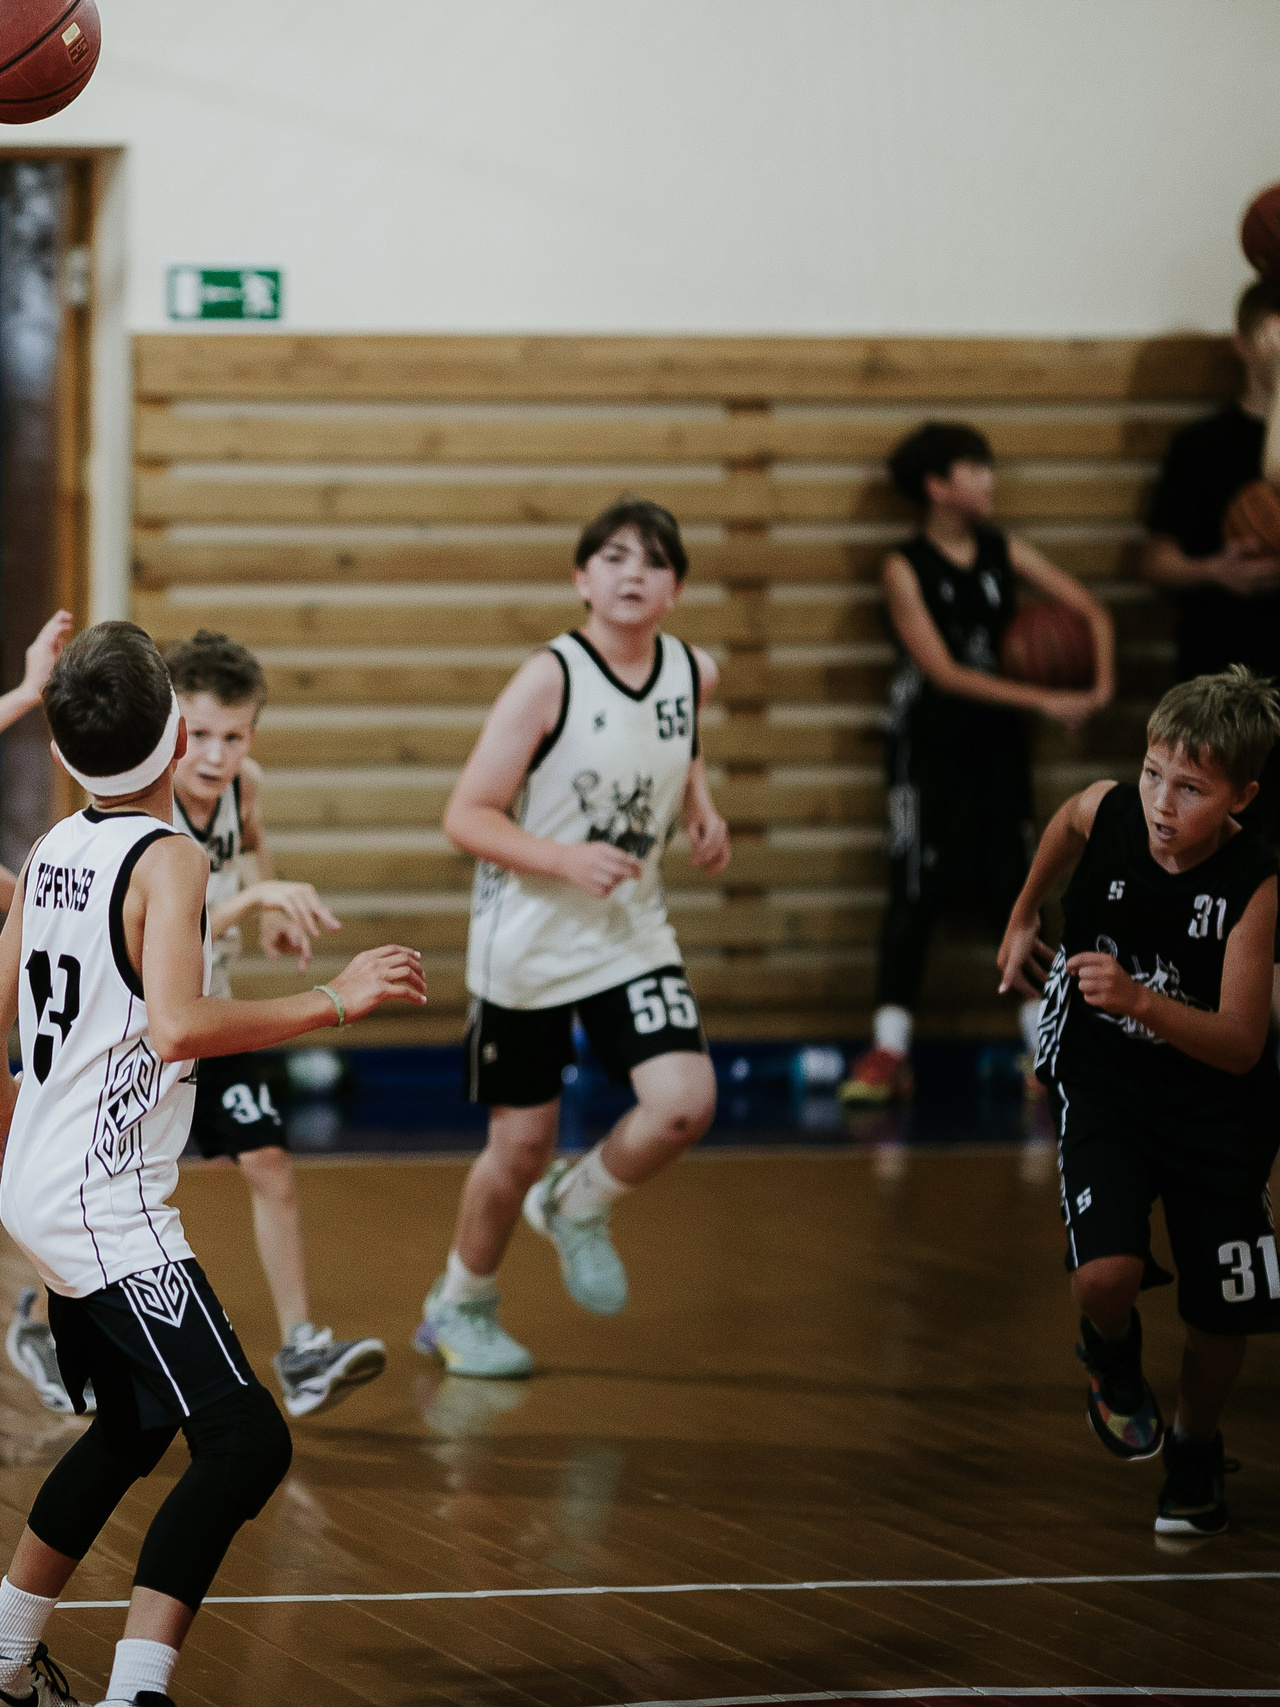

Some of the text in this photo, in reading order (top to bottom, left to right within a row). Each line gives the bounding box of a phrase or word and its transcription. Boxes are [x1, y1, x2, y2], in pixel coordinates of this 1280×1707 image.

[656, 696, 689, 740] 55
[1187, 893, 1227, 941] 31
[626, 976, 698, 1035] 55
[1218, 1235, 1280, 1302] 31
